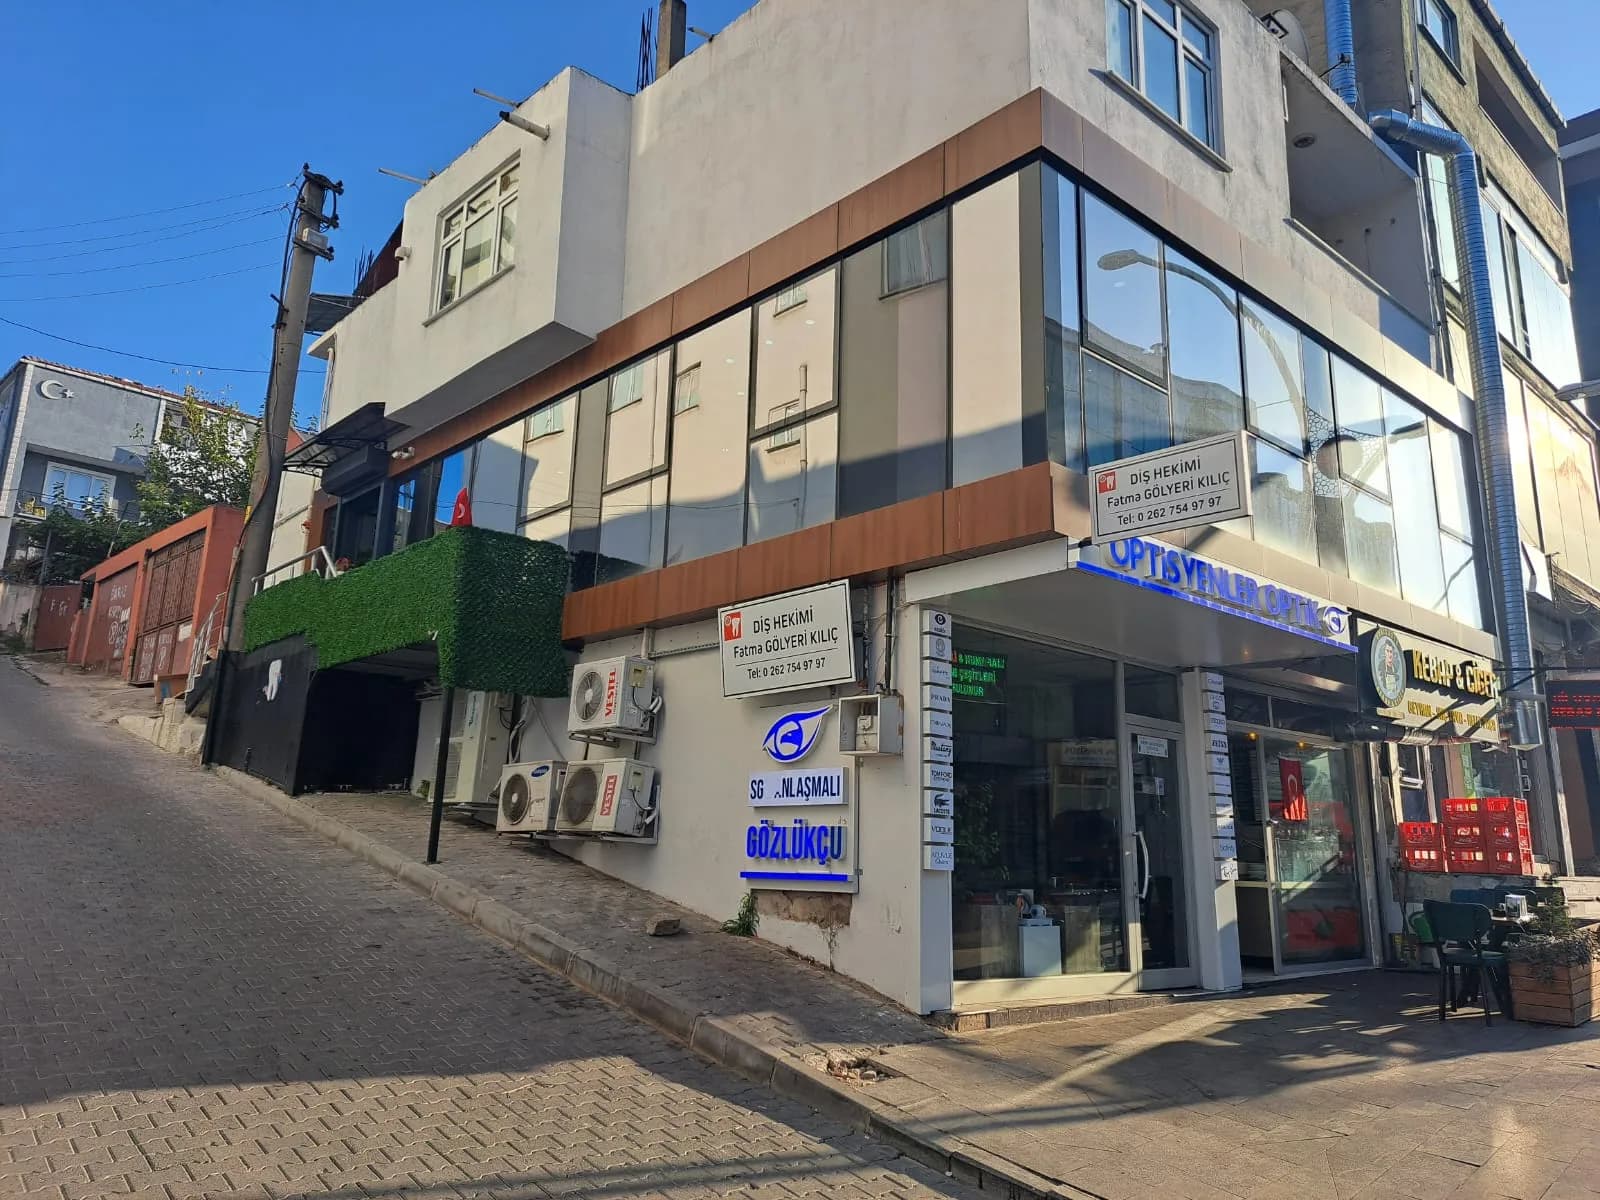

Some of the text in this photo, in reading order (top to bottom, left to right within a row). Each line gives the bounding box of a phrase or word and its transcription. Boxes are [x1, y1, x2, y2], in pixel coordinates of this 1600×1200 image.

[1130, 455, 1201, 485] DİŞ HEKİMİ
[1107, 471, 1230, 508] Fatma GÖLYERİ KILIÇ
[1117, 495, 1222, 526] Tel: 0 262 754 97 97
[753, 604, 813, 634] DİŞ HEKİMİ
[733, 627, 839, 659] Fatma GÖLYERİ KILIÇ
[747, 657, 826, 680] Tel: 0 262 754 97 97
[604, 667, 617, 718] VESTEL
[601, 775, 618, 816] VESTEL
[774, 775, 840, 801] NLAŞMALI
